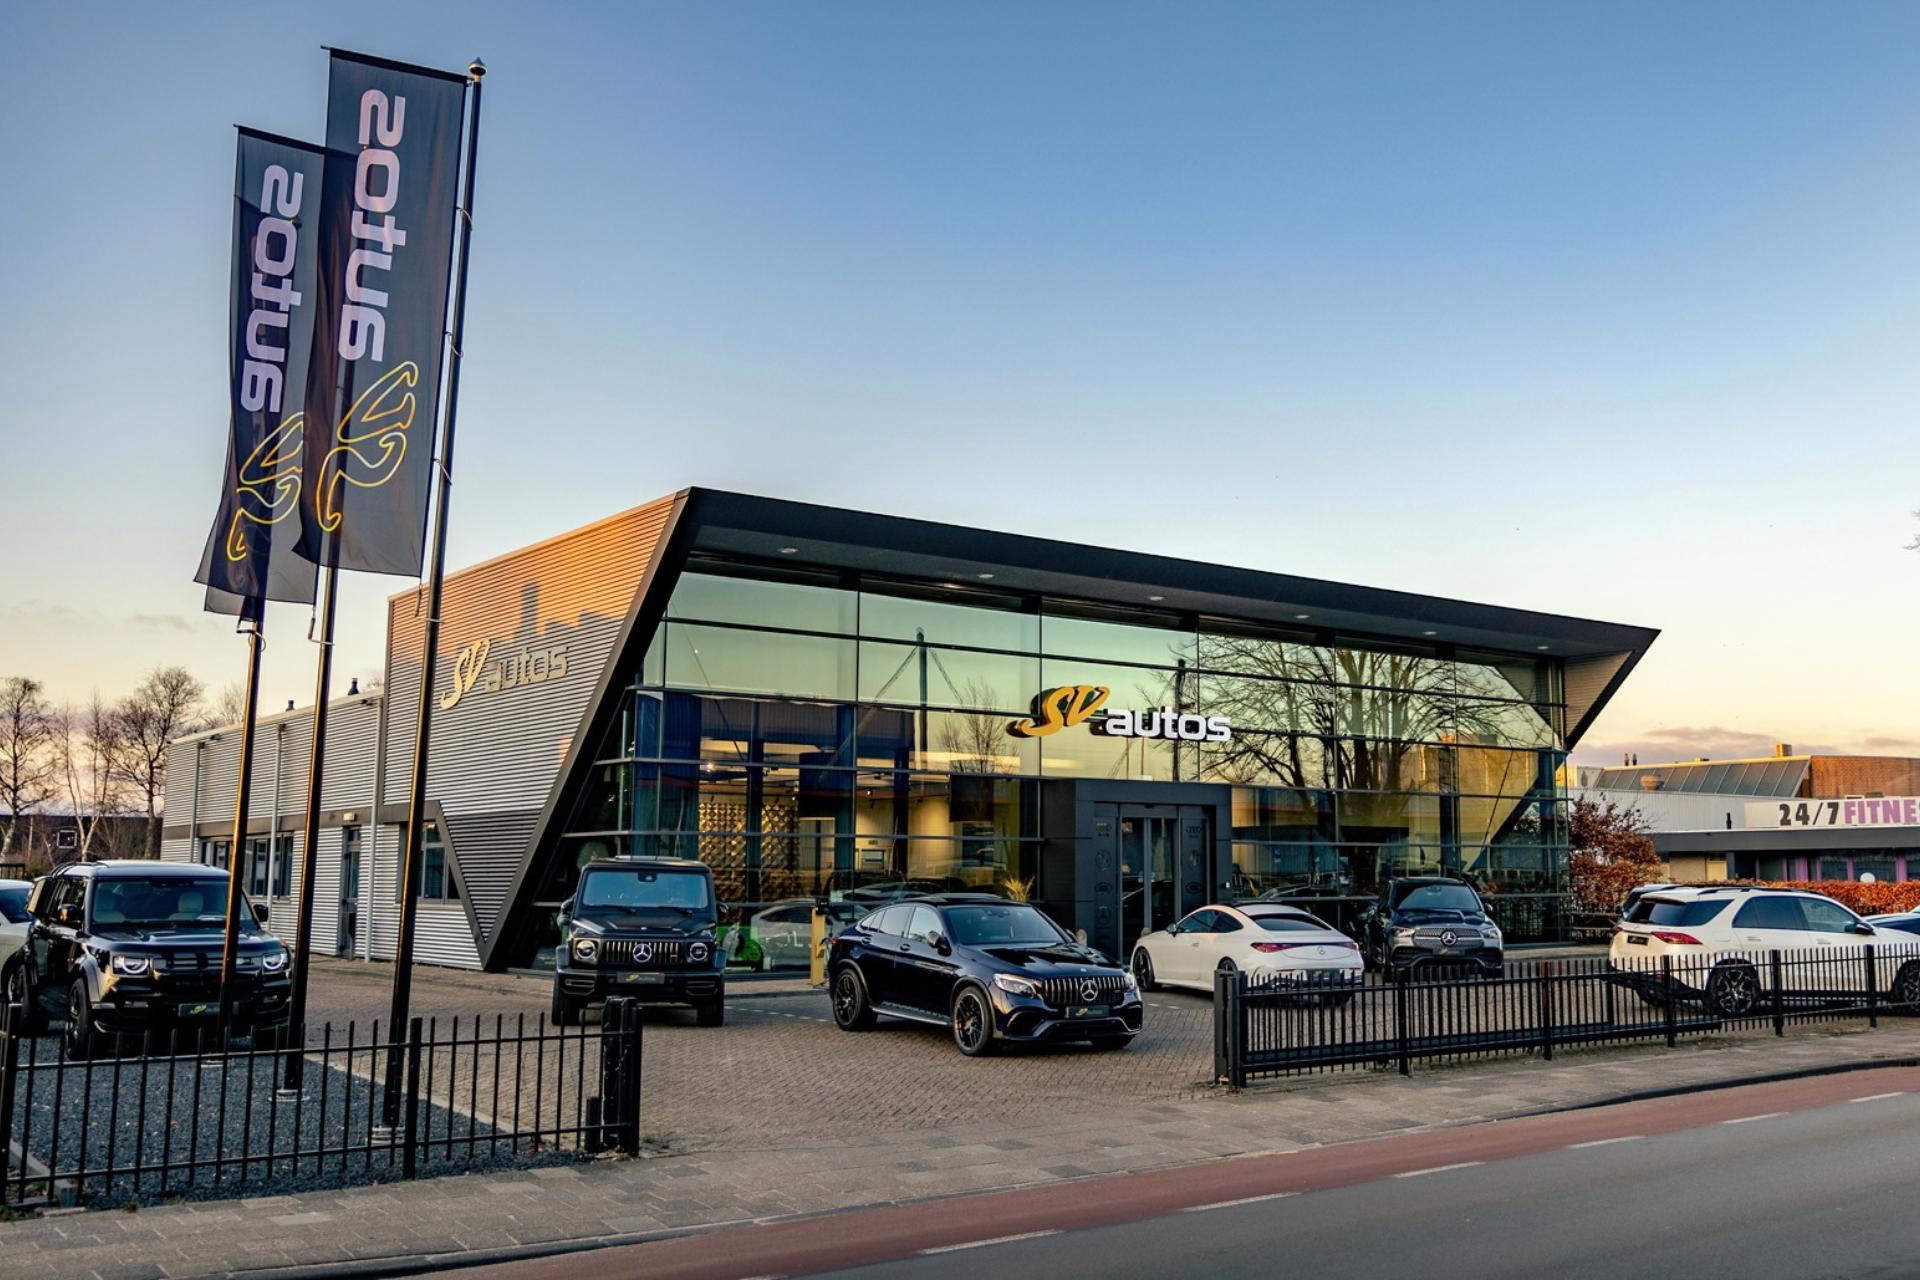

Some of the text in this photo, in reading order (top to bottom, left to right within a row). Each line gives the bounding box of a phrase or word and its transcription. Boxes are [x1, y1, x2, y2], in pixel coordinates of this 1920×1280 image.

[484, 646, 567, 693] autos
[1105, 705, 1231, 742] autos
[1779, 799, 1920, 826] 24/7 FITNE
